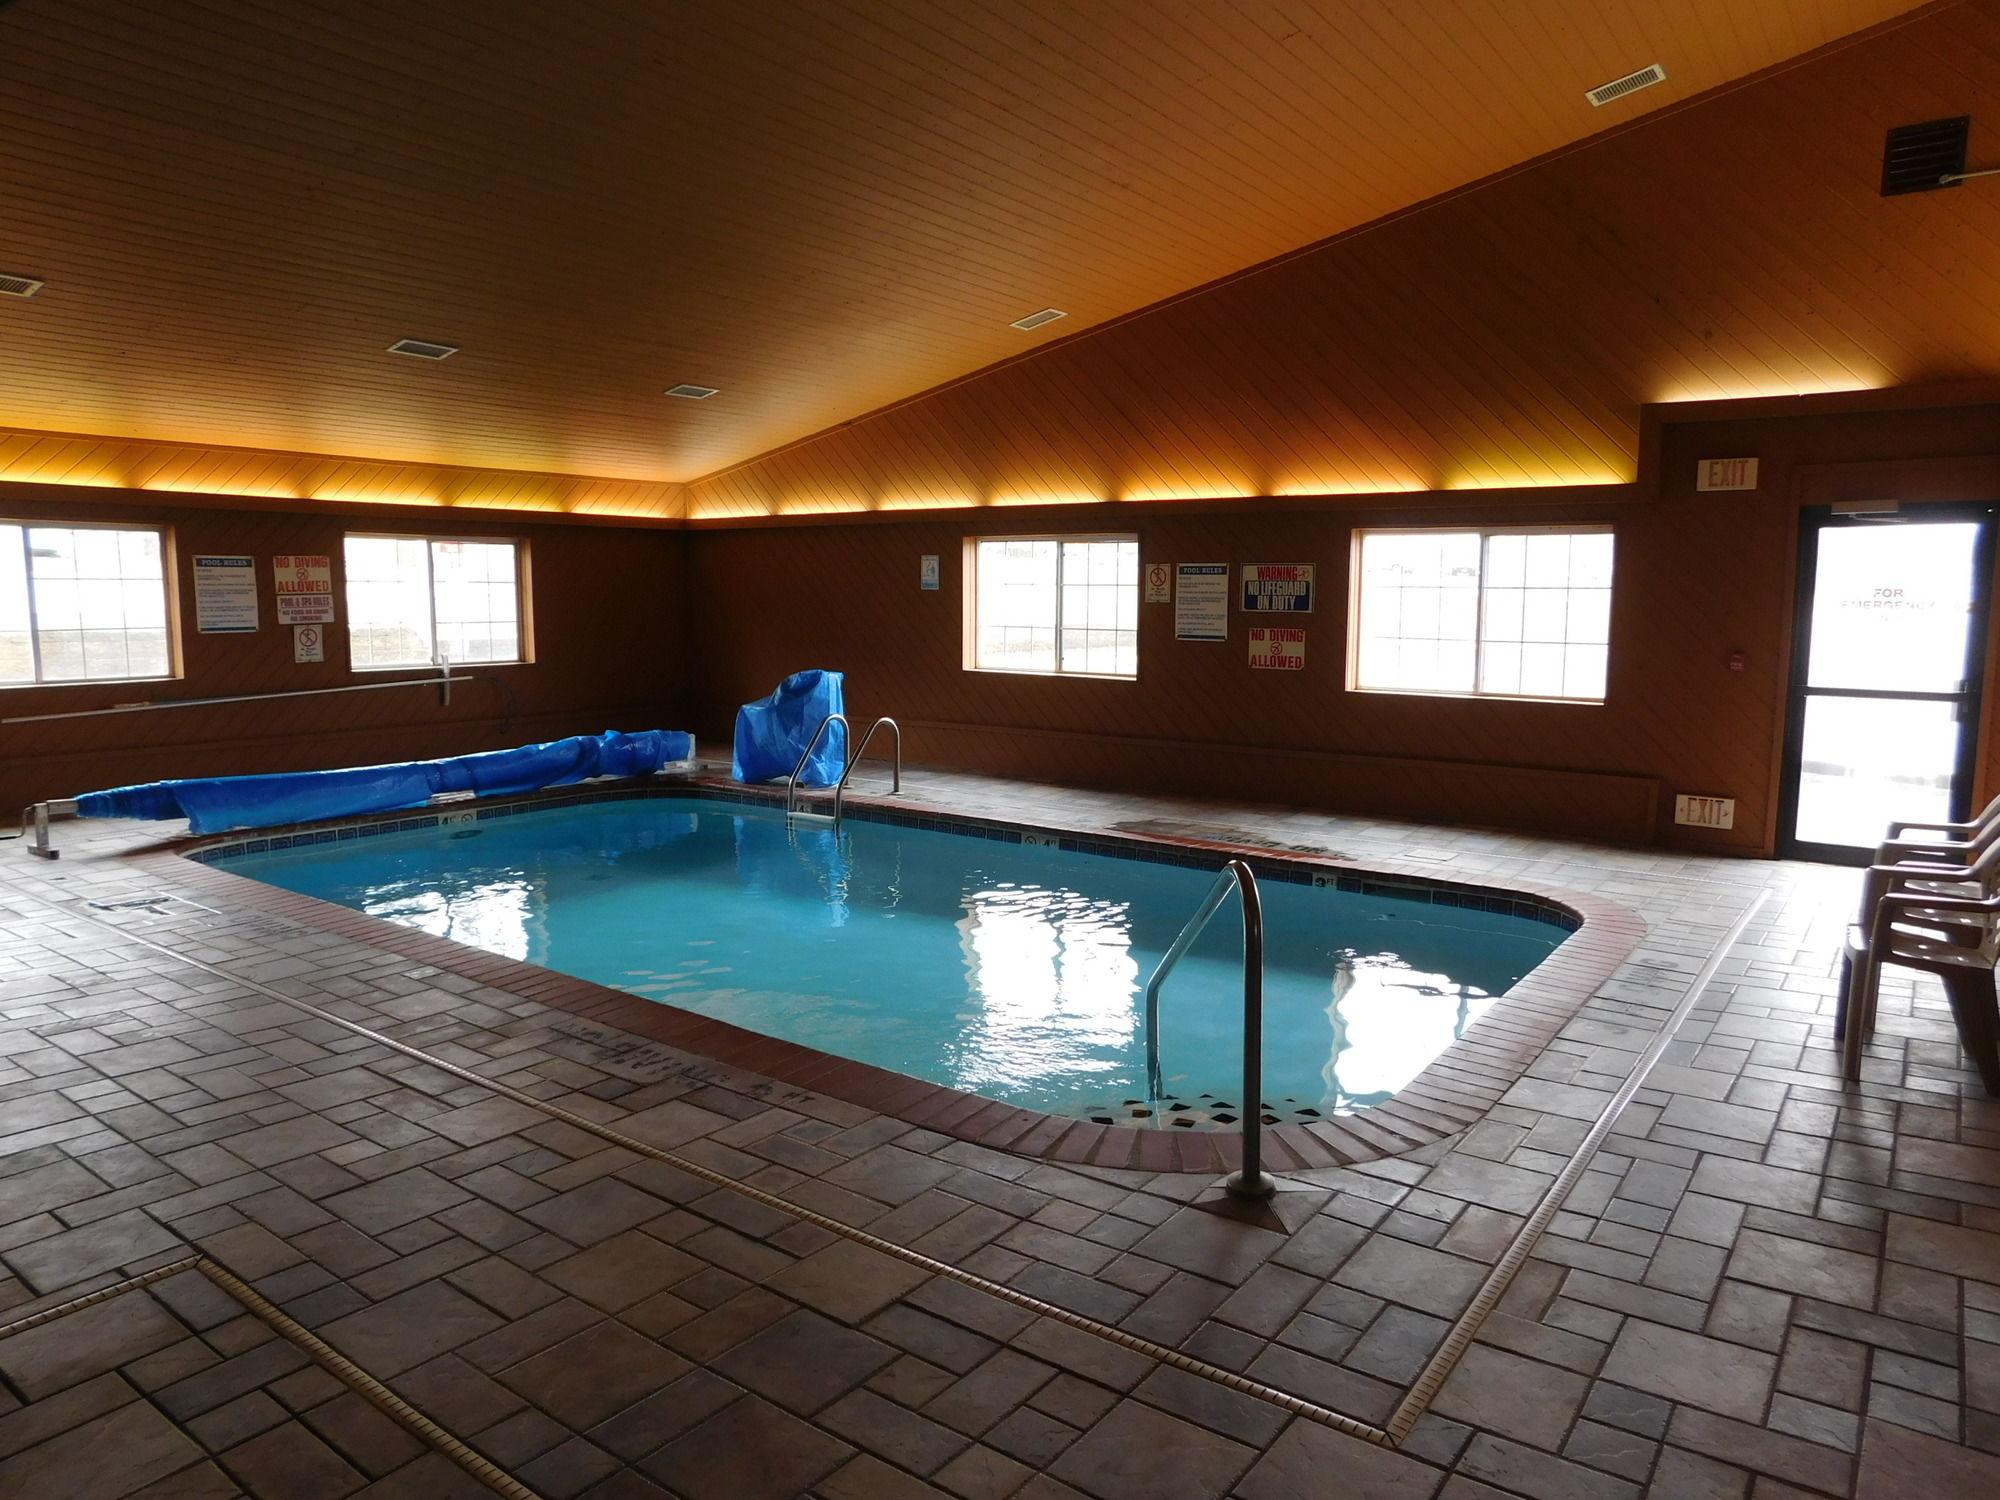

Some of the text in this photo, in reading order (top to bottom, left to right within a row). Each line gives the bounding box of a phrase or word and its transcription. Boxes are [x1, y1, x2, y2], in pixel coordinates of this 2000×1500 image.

[1708, 460, 1749, 487] EXIT
[275, 556, 328, 568] NO DIVING
[1257, 566, 1298, 580] WARNING
[278, 580, 328, 592] ALLOWED
[1247, 581, 1306, 596] NO LIFEGUARD
[1873, 588, 1904, 598] FOR
[1257, 596, 1296, 610] ON DUTY
[1250, 629, 1304, 642] NO DIVING
[1250, 655, 1302, 668] ALLOWED
[1687, 797, 1725, 825] EXIT
